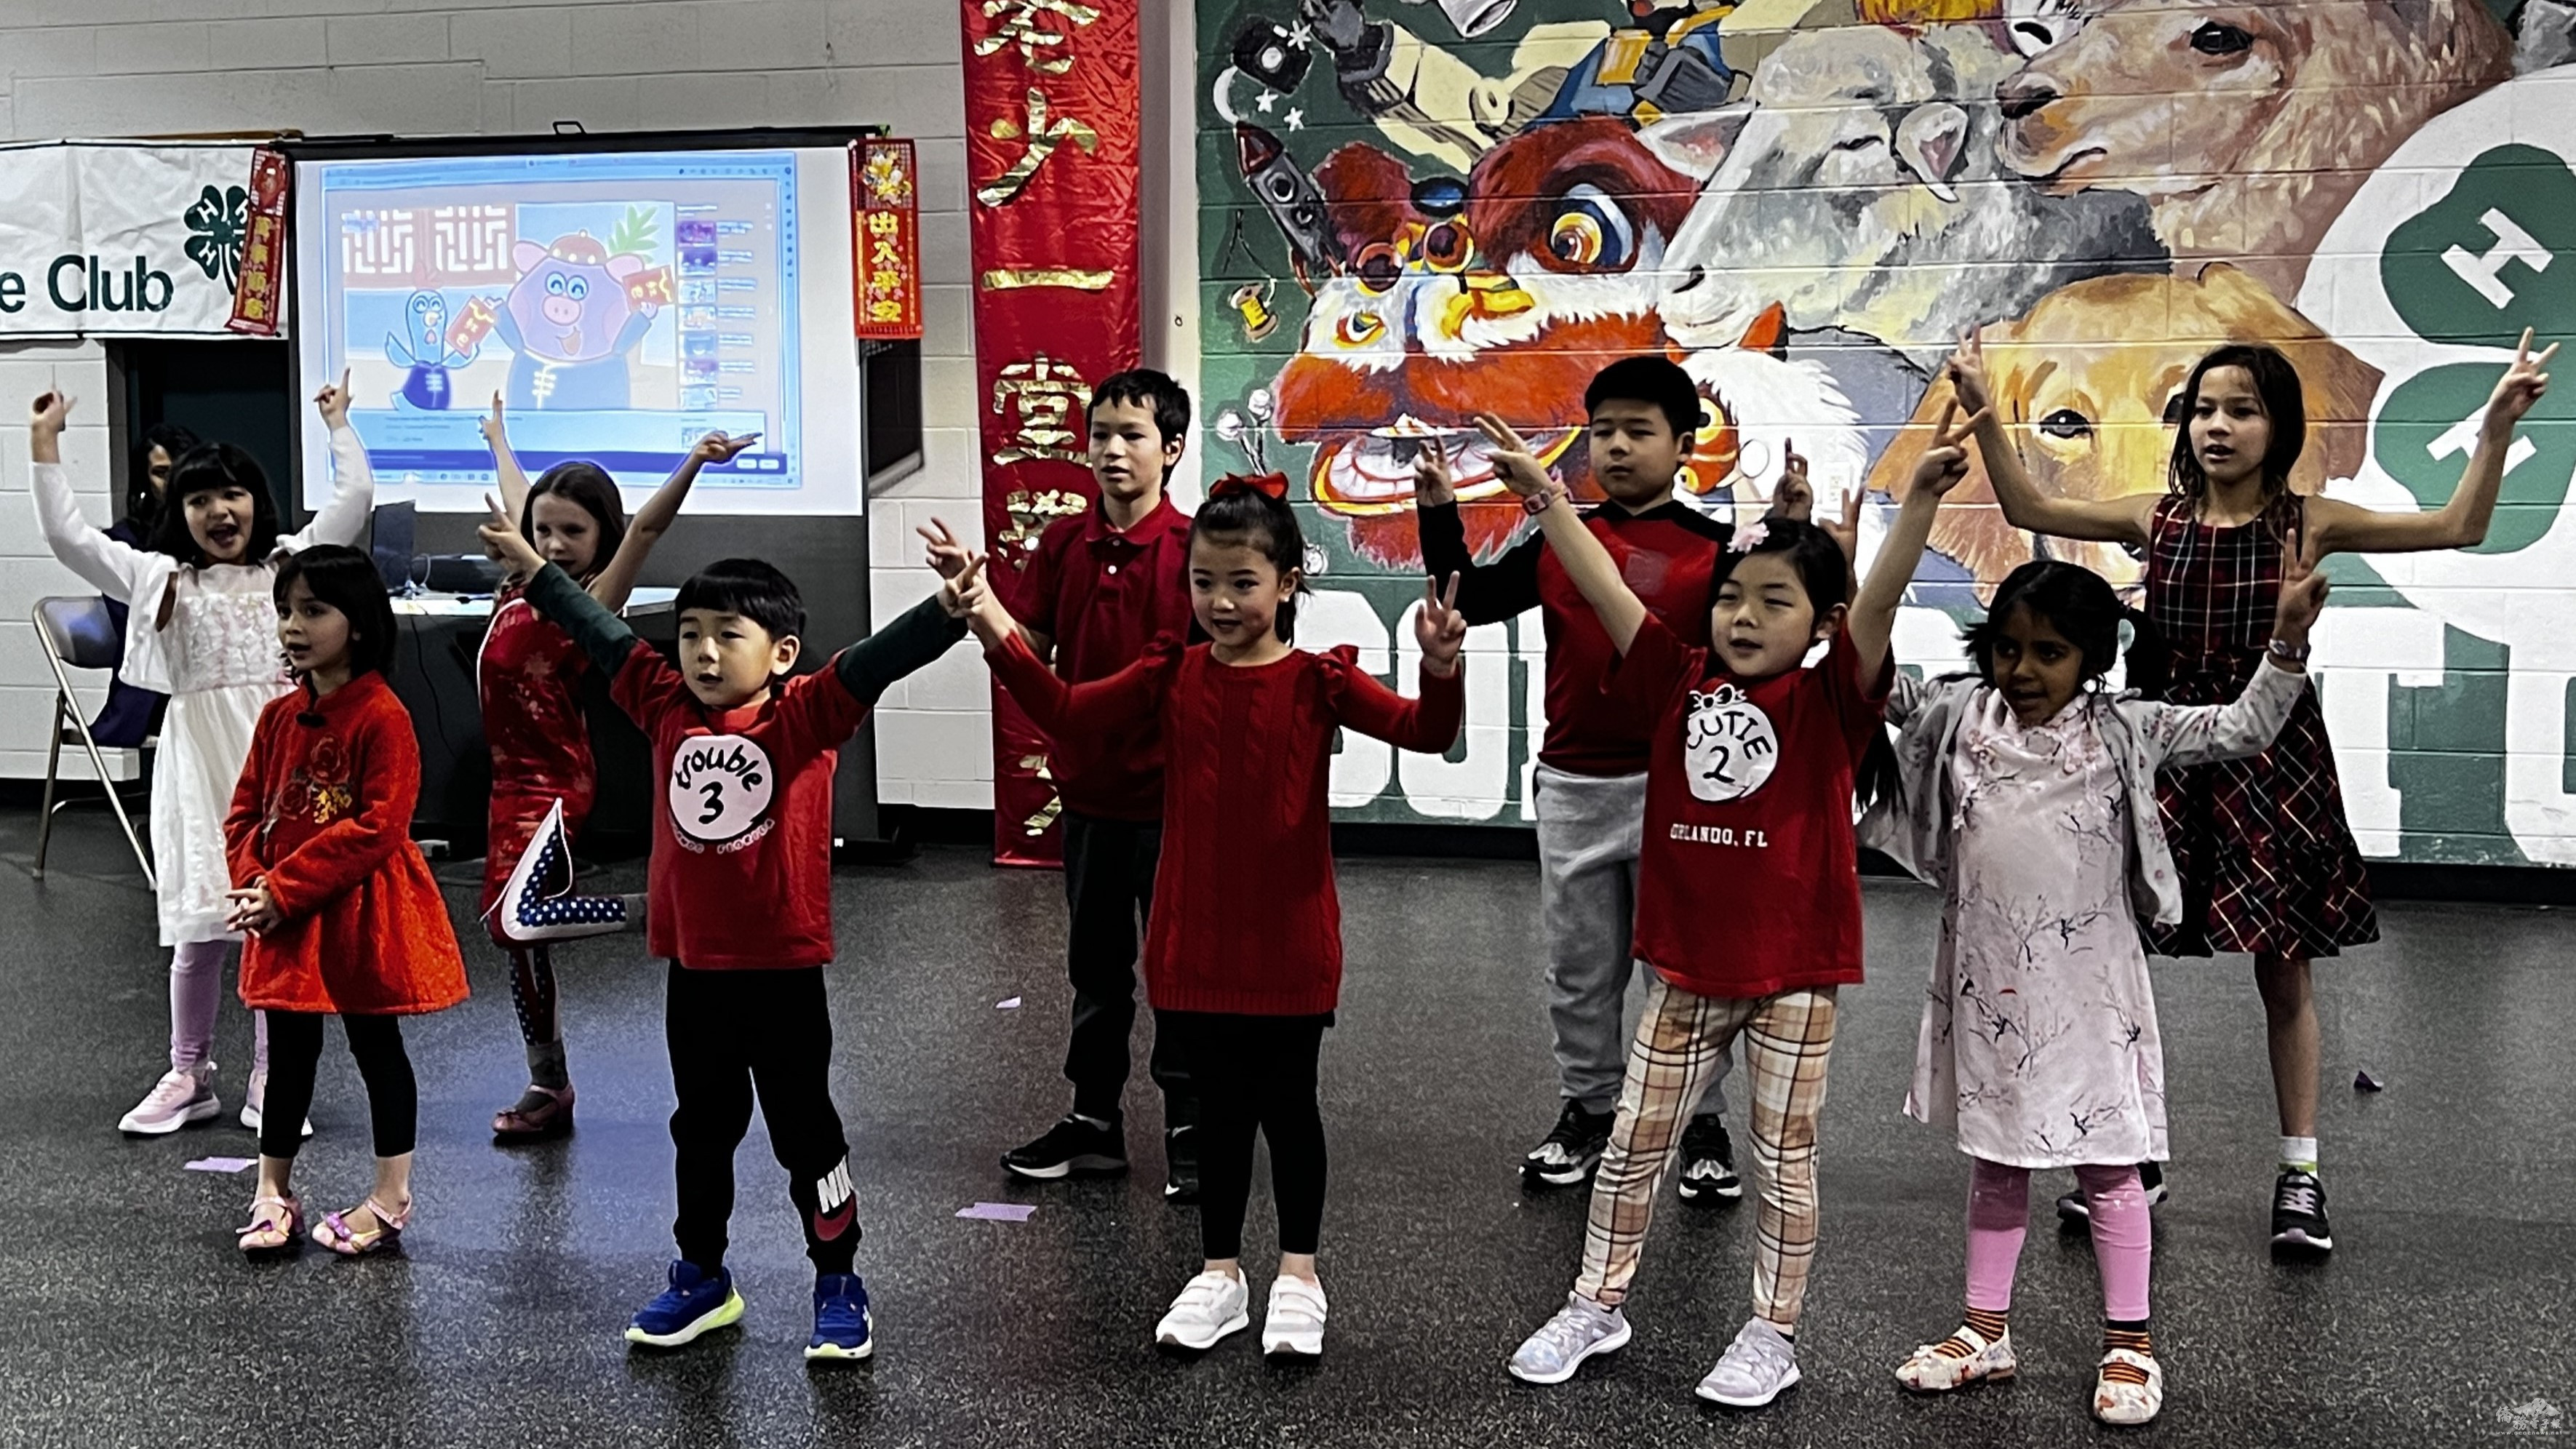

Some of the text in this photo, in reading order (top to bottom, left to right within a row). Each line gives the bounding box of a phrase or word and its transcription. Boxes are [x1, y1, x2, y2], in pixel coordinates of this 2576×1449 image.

[868, 211, 902, 323] 出入平安
[2440, 207, 2554, 309] H
[47, 254, 174, 313] Club
[674, 744, 762, 792] trouble
[1702, 746, 1736, 783] 2
[698, 781, 725, 824] 3
[1744, 830, 1768, 847] FL
